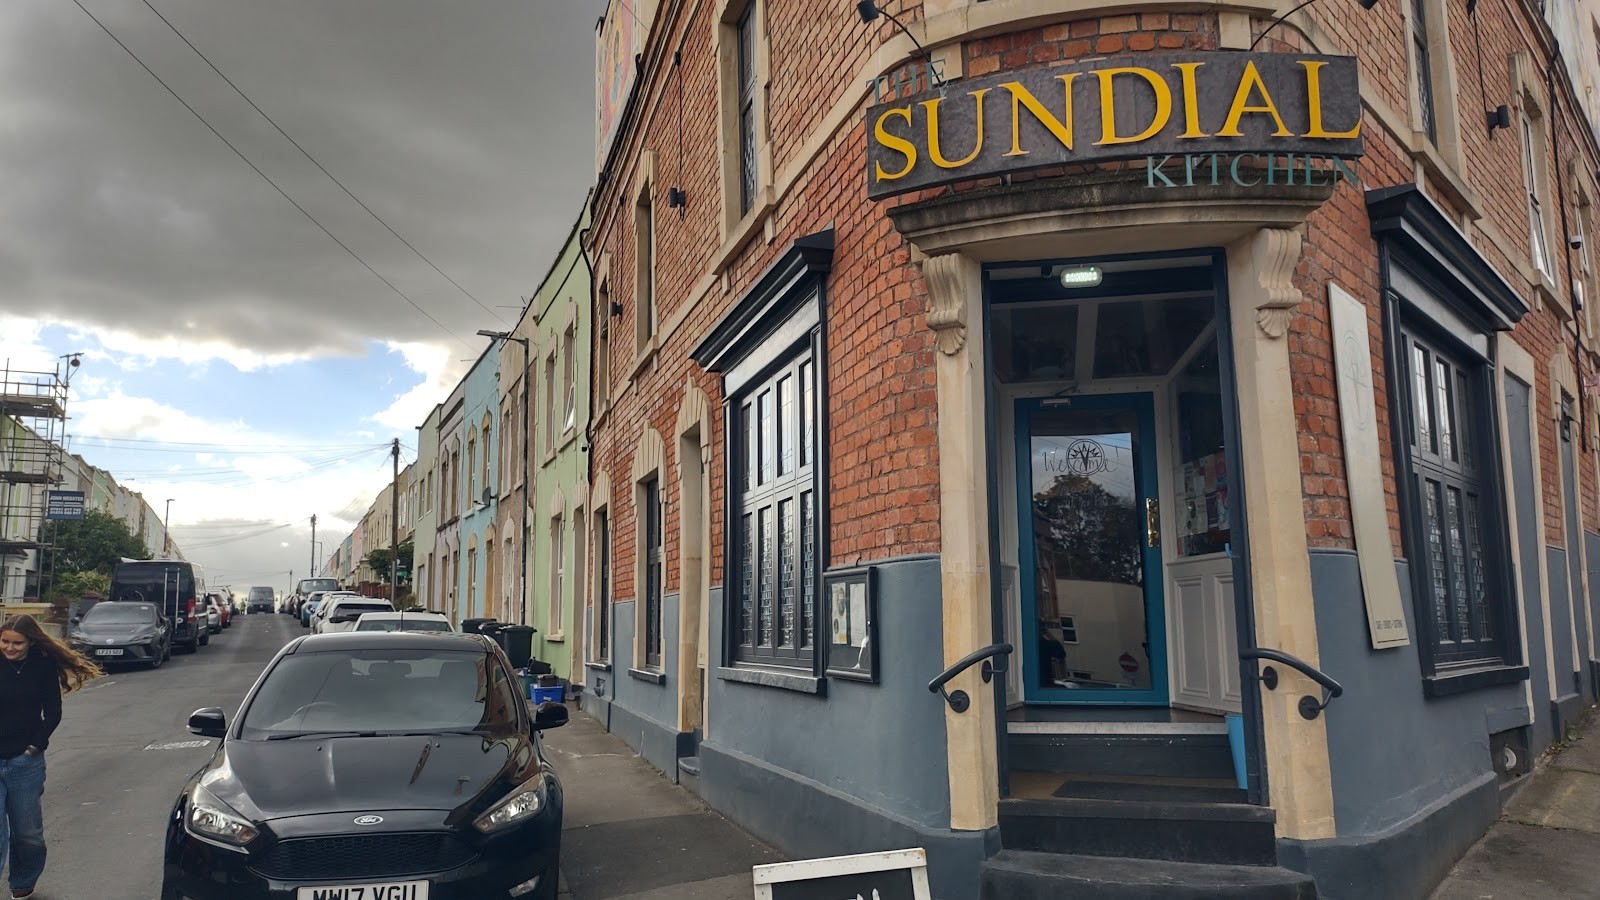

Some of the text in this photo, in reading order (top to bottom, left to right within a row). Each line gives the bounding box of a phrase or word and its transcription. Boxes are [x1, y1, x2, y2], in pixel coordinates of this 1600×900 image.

[866, 58, 948, 105] THE
[874, 59, 1361, 182] SUNDIAL
[1144, 152, 1361, 189] KITCHEN
